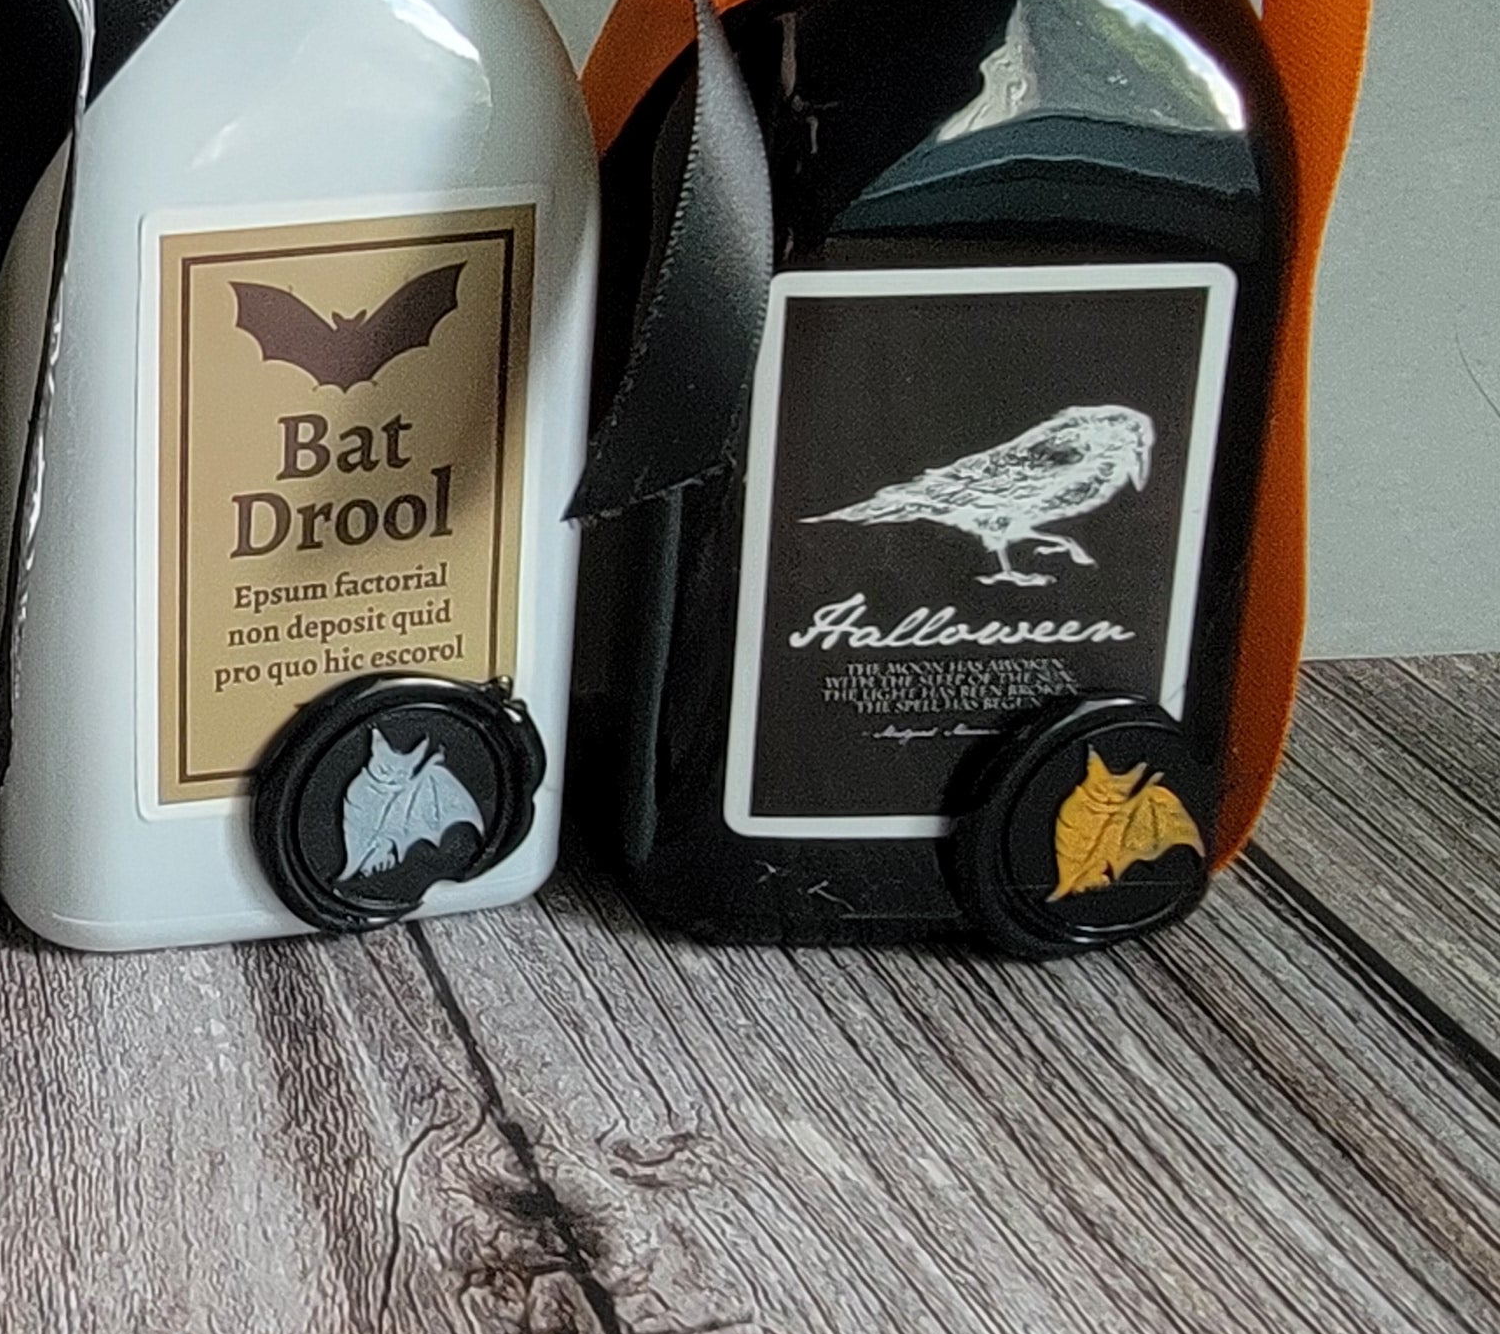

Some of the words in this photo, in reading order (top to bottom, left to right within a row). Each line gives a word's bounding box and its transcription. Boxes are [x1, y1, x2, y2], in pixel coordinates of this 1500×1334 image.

[276, 412, 413, 482] Bat
[230, 465, 453, 559] Drool
[234, 581, 327, 614] Epsum
[335, 562, 448, 598] factorial
[228, 624, 280, 647] non
[286, 607, 387, 643] deposit
[392, 598, 451, 636] quid
[789, 593, 1136, 649] Halloween
[214, 665, 261, 692] pro
[267, 657, 319, 686] quo
[323, 647, 364, 674] hic
[370, 635, 463, 668] escorol
